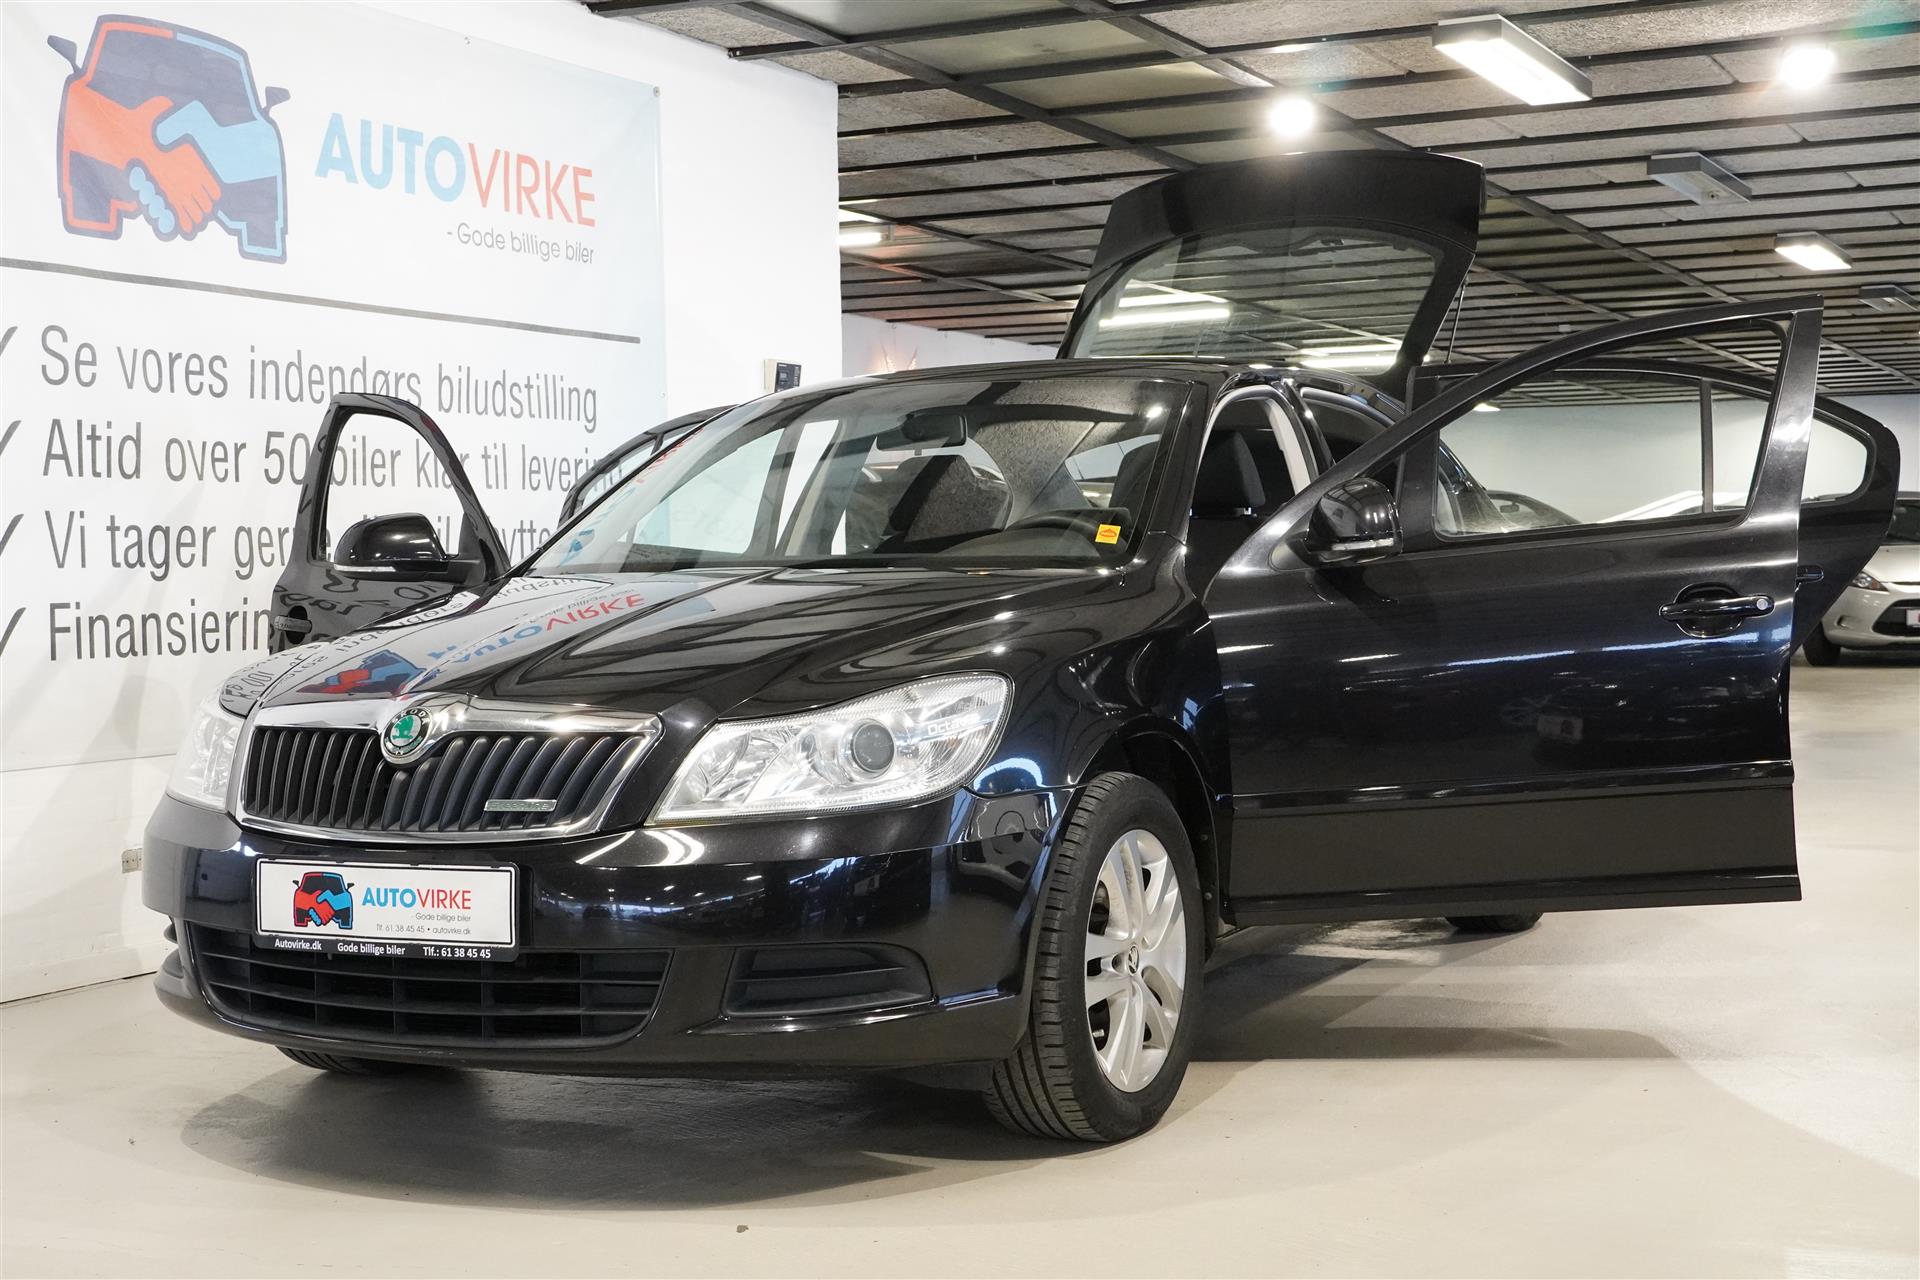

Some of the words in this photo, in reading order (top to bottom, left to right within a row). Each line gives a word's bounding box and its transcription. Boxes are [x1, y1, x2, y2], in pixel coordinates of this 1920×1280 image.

[314, 112, 596, 227] AUTOVIRKE
[457, 222, 506, 250] Gode
[510, 231, 561, 262] billige
[565, 240, 595, 264] biler
[41, 325, 97, 387] Se
[117, 346, 228, 398] vores
[249, 344, 422, 407] indendørs
[438, 363, 597, 434] biludstilling
[43, 418, 141, 479] Altid
[165, 437, 246, 483] over
[264, 431, 311, 485] 50
[481, 443, 508, 490] til
[45, 510, 85, 569] Vi
[106, 515, 216, 581] tager
[49, 597, 271, 661] Finansierin
[362, 887, 471, 910] AUTOVIRKE
[415, 912, 435, 921] Gode
[274, 938, 322, 951] Autovirke.dk
[337, 942, 359, 953] Gode
[360, 943, 385, 956] billige
[386, 944, 406, 955] biler
[422, 946, 440, 957] Tlf.:
[441, 947, 453, 957] 61
[453, 947, 466, 958] 38
[466, 948, 478, 958] 45
[479, 949, 492, 959] 45
[385, 924, 393, 932] 61
[395, 925, 404, 933] 38
